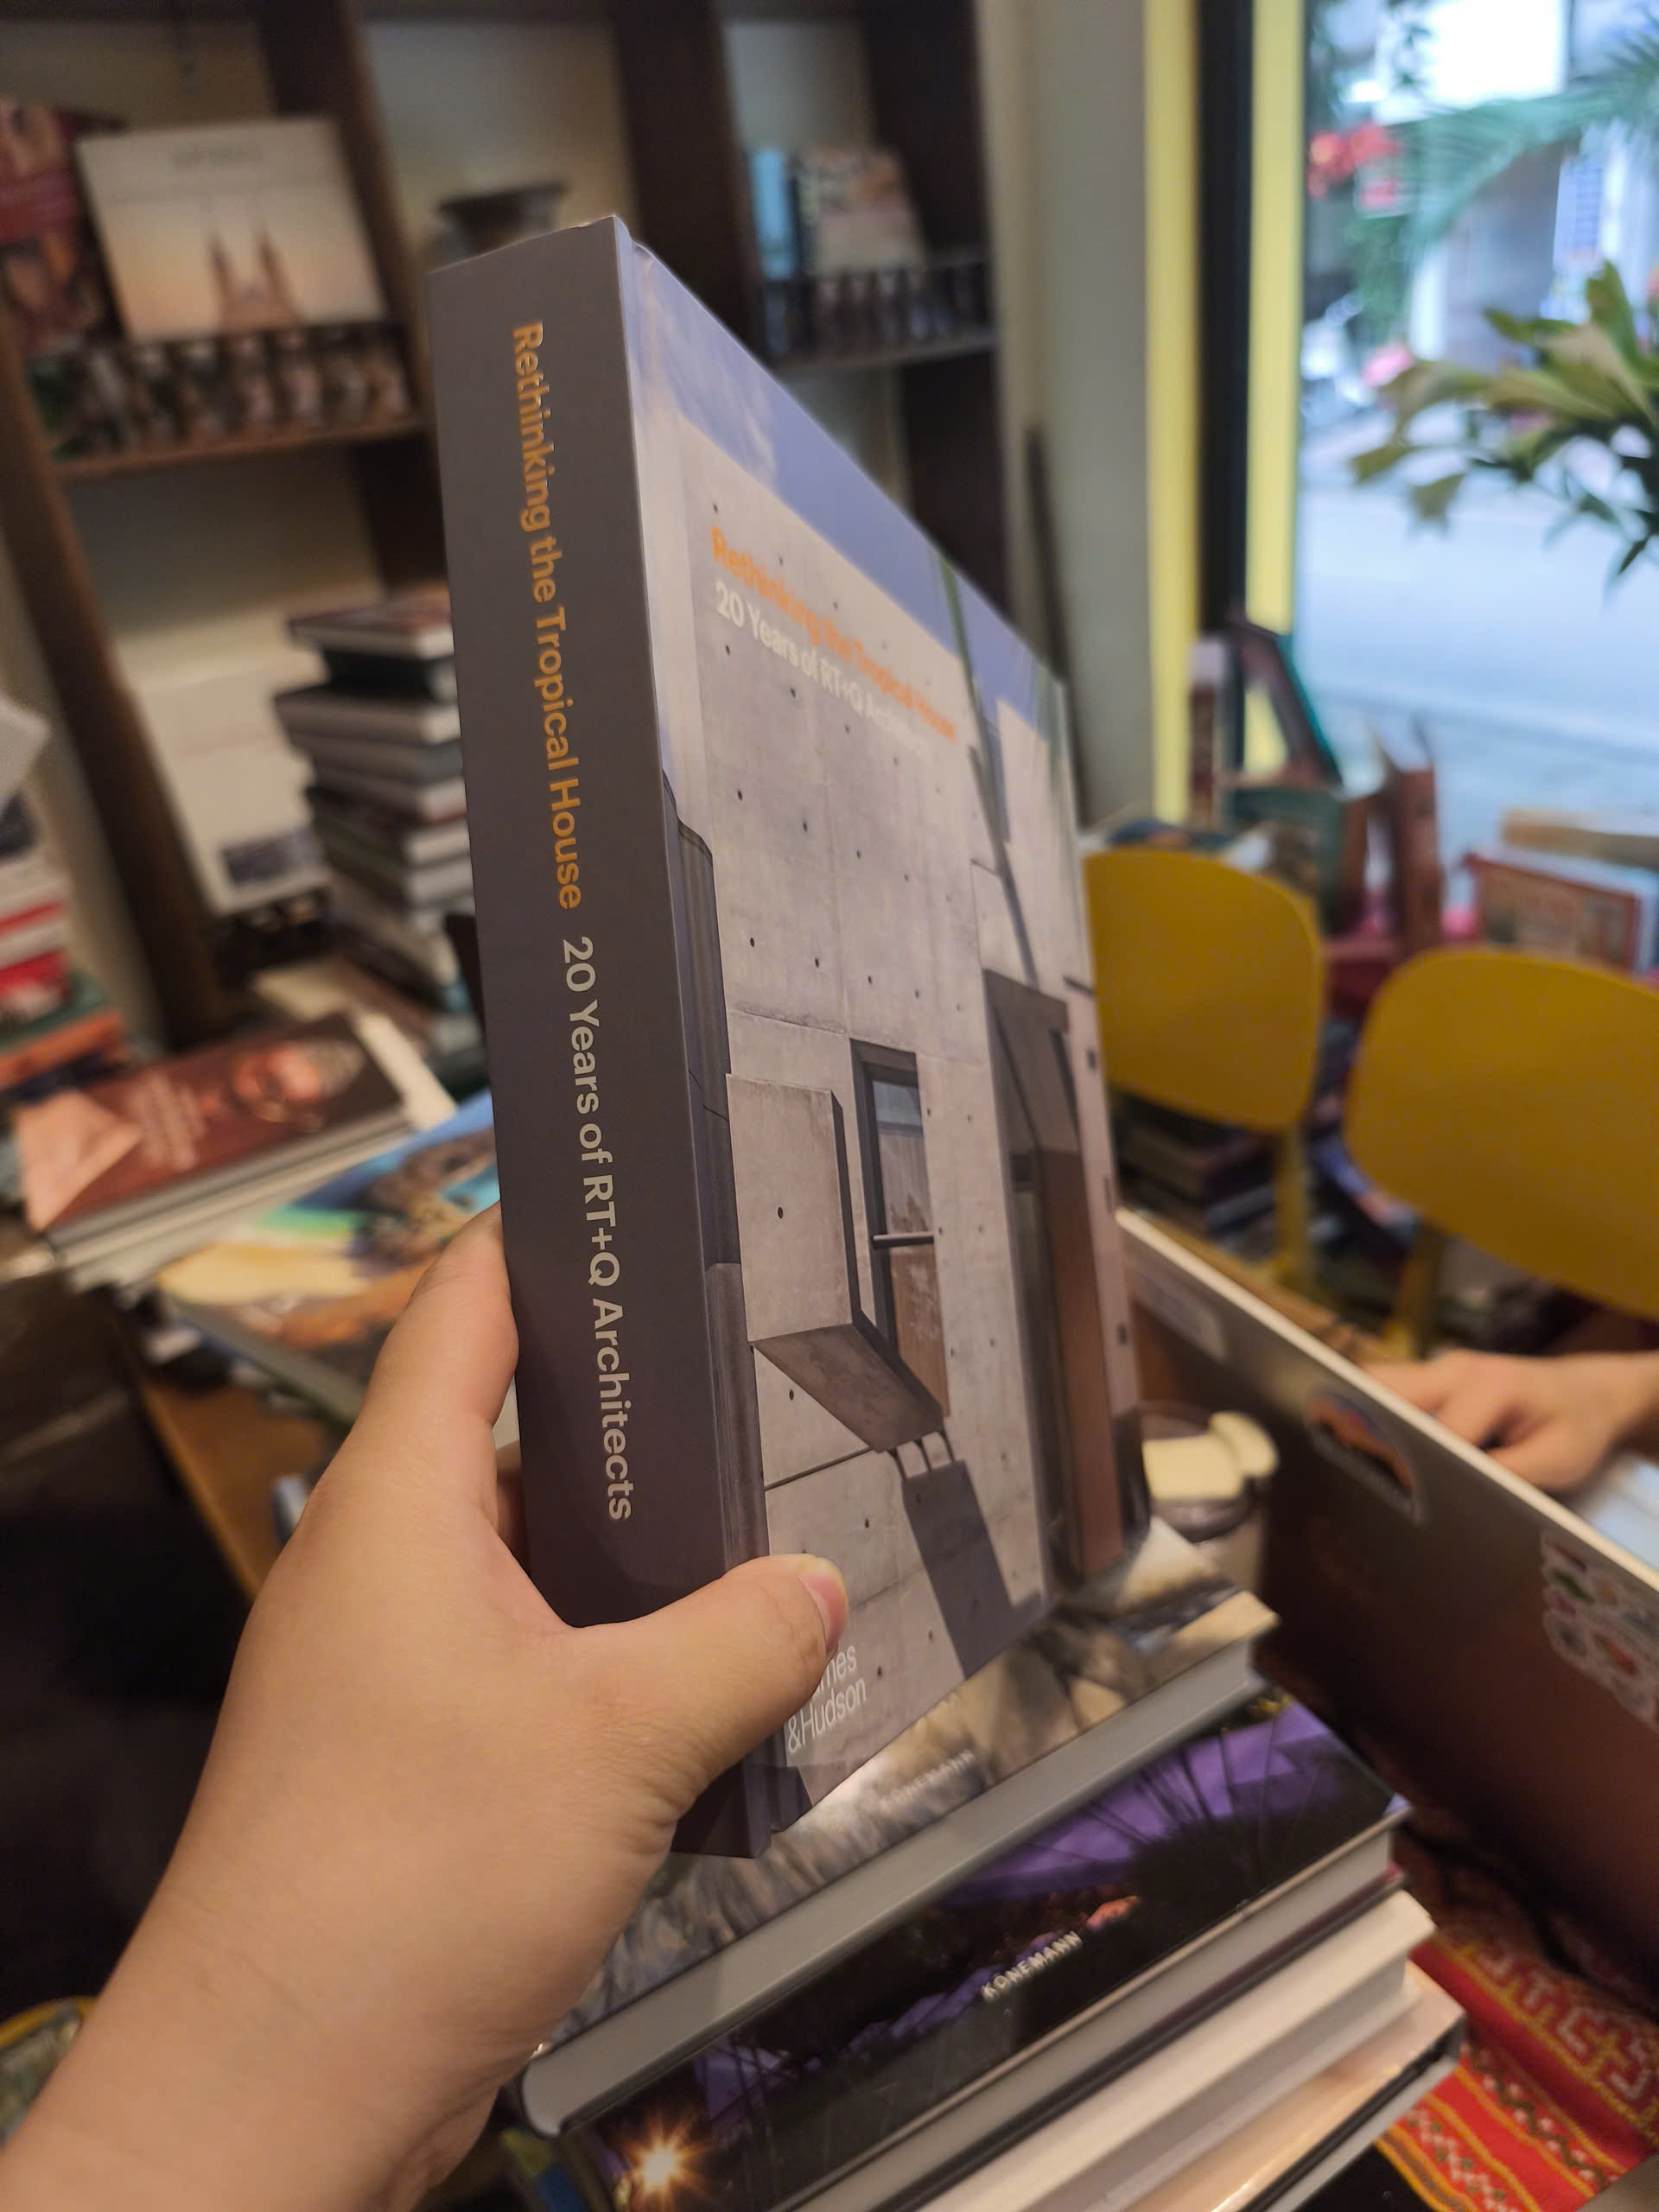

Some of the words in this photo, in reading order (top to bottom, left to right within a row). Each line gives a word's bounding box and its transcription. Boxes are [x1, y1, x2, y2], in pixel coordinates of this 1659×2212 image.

[512, 321, 555, 531] Rethinking
[530, 536, 563, 602] the
[715, 580, 745, 629] 20
[746, 602, 799, 668] Years
[800, 651, 818, 683] of
[534, 606, 579, 771] Tropical
[550, 779, 582, 909] House
[563, 936, 596, 992] 20
[569, 999, 600, 1115] Years
[579, 1123, 613, 1164] of
[583, 1174, 620, 1287] RT+Q
[593, 1298, 634, 1521] Architects
[788, 1677, 867, 1754] &Hudson
